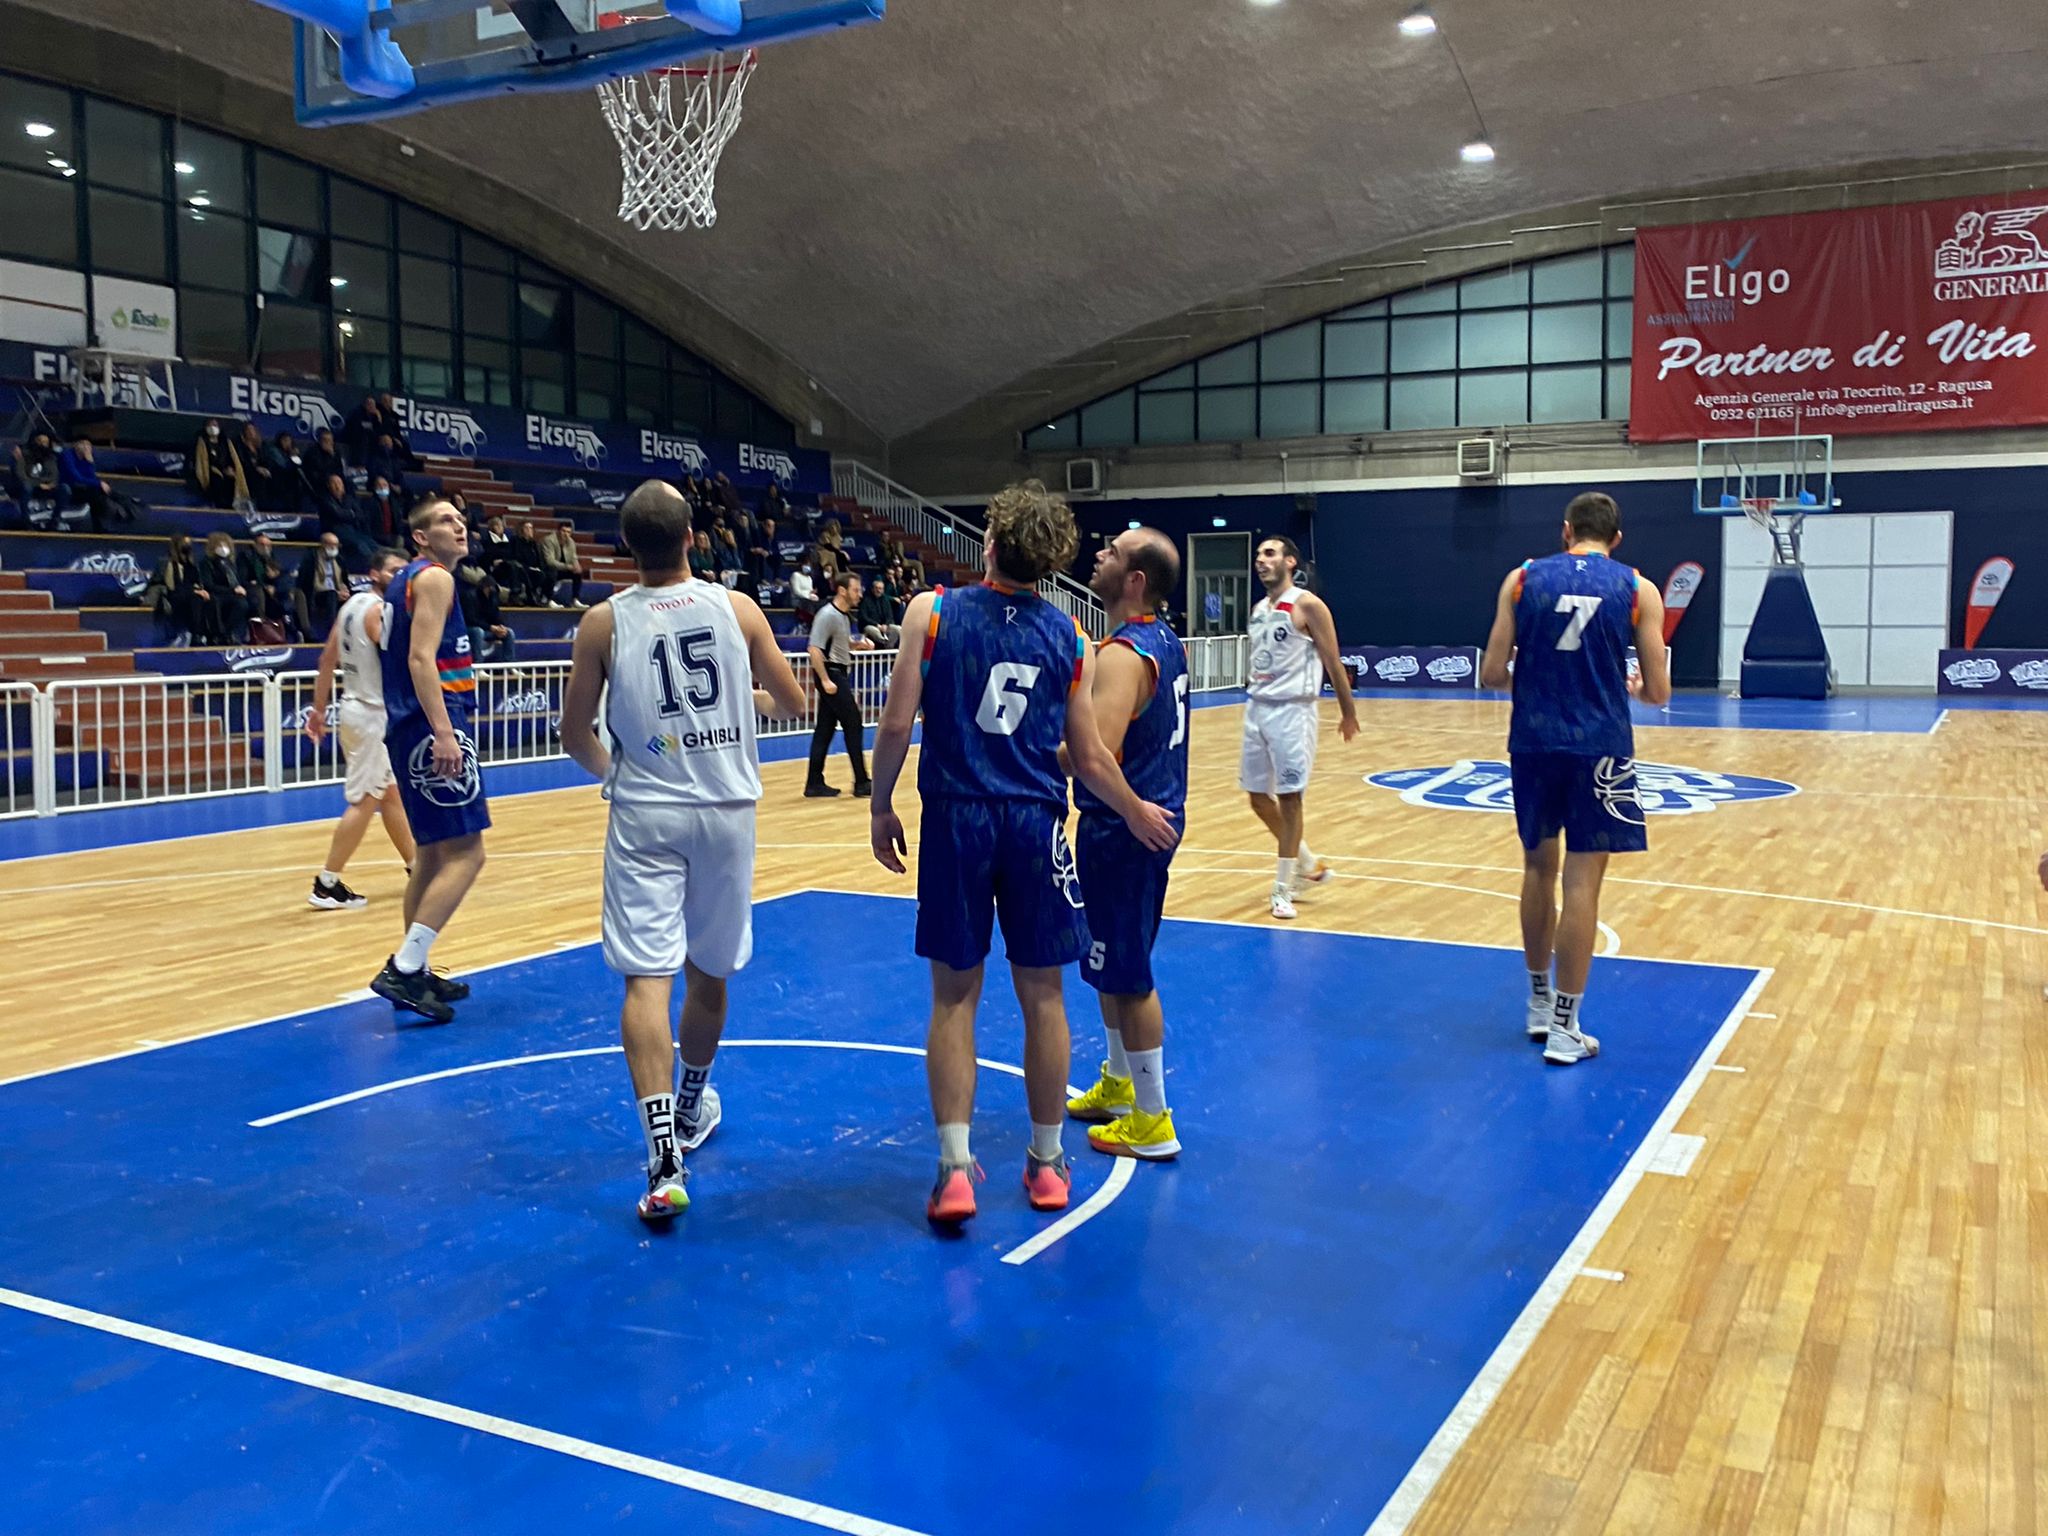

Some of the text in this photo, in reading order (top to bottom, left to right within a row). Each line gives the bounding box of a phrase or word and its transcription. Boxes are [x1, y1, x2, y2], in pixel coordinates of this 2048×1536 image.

[1685, 263, 1791, 305] Eligo
[1657, 319, 2037, 381] Partner di Vita
[229, 376, 301, 417] Ekso
[1694, 392, 1749, 408] Agenzia
[1751, 388, 1815, 403] Generale
[1817, 387, 1840, 400] via
[1841, 384, 1905, 398] Teocrito,
[1908, 382, 1926, 395] 12
[1937, 380, 1993, 394] Ragusa
[1710, 408, 1744, 421] 0932
[1805, 396, 1974, 418] info@generaliragusa.it
[392, 397, 450, 433] Ekso
[526, 414, 577, 448] Ekso
[640, 429, 684, 461] Ekso
[738, 442, 776, 472] Ekso
[649, 596, 696, 612] TOYOTA
[1554, 594, 1603, 651] 7
[456, 635, 471, 653] 5
[650, 626, 721, 718] 15
[975, 661, 1041, 736] 6
[682, 727, 740, 748] GHIBLI
[1088, 941, 1106, 971] 5
